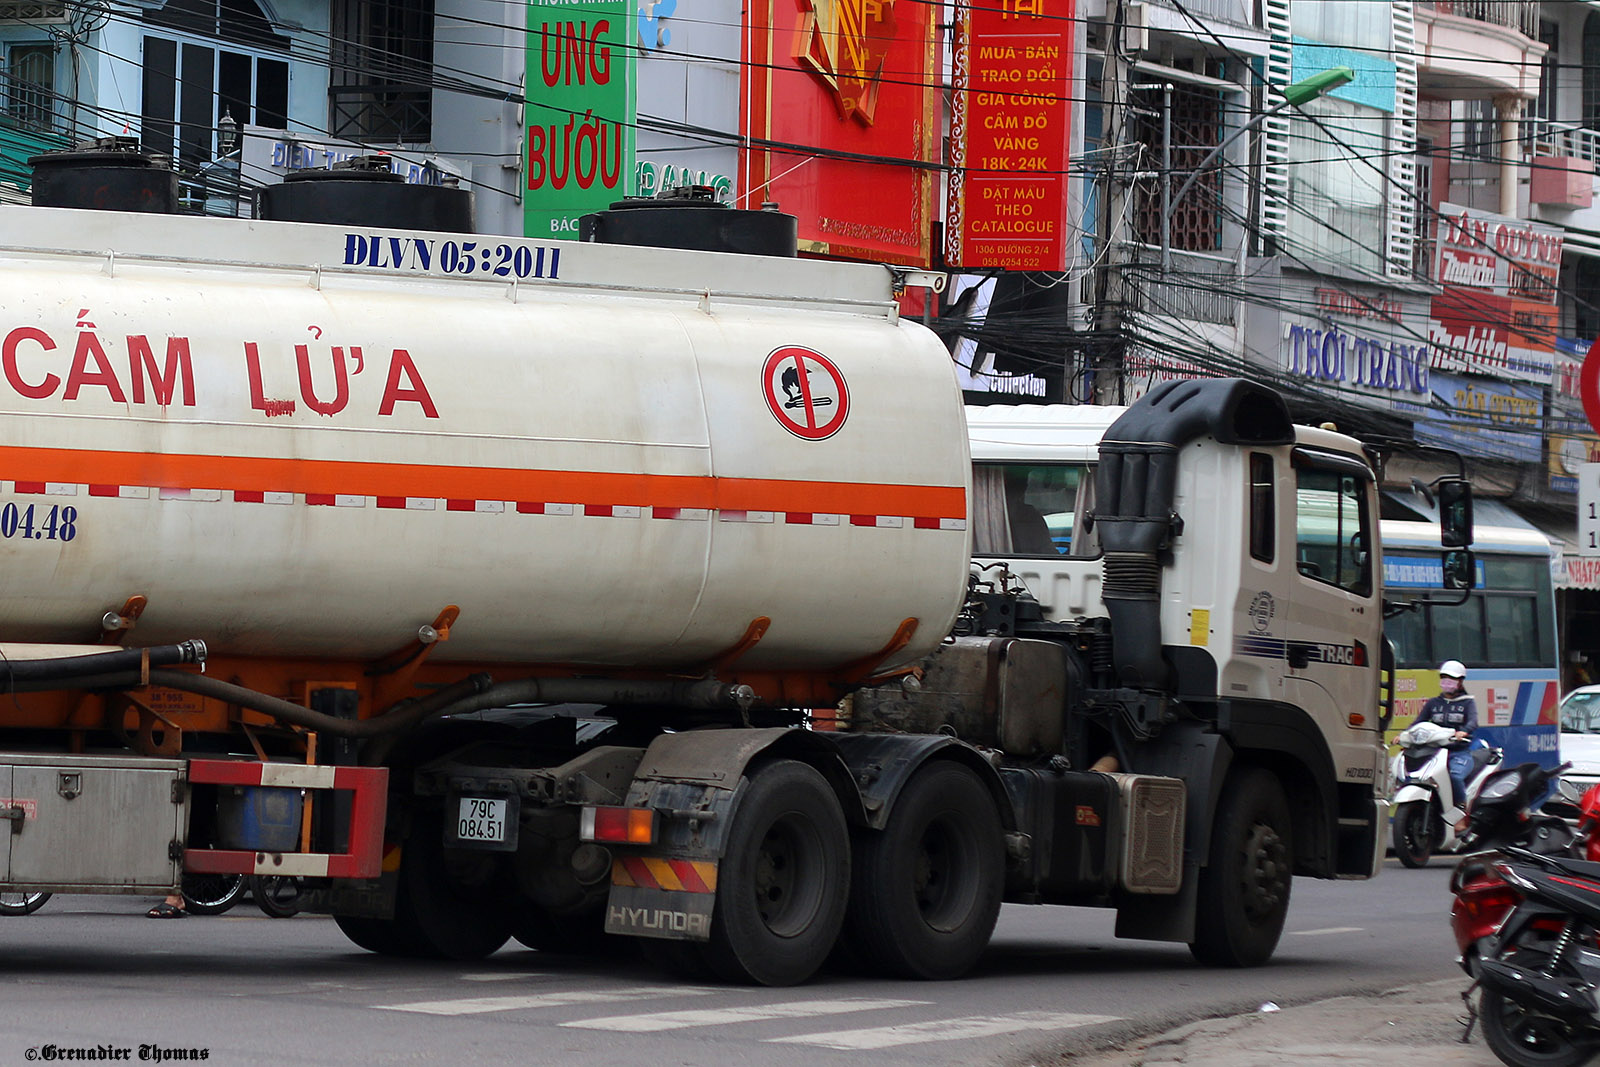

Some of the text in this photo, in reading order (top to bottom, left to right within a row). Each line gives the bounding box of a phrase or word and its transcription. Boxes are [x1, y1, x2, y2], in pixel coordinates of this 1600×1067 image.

[542, 20, 610, 87] UNG
[981, 62, 1056, 82] TRAO ĐỔI
[977, 89, 1057, 106] GIA CÔNG
[984, 111, 1047, 129] CẦM ĐỒ
[528, 109, 622, 190] BƯỚU
[993, 133, 1039, 150] VÀNG
[983, 184, 1009, 202] ĐẶT
[995, 204, 1033, 216] THEO
[550, 216, 579, 232] BÁC
[971, 221, 1054, 233] CATALOGUE
[342, 234, 561, 279] ĐLVN 05:2011
[1, 309, 440, 418] CẤM LỬA
[1350, 335, 1429, 394] TRANG
[470, 800, 496, 818] 79C
[459, 819, 503, 840] 084.51
